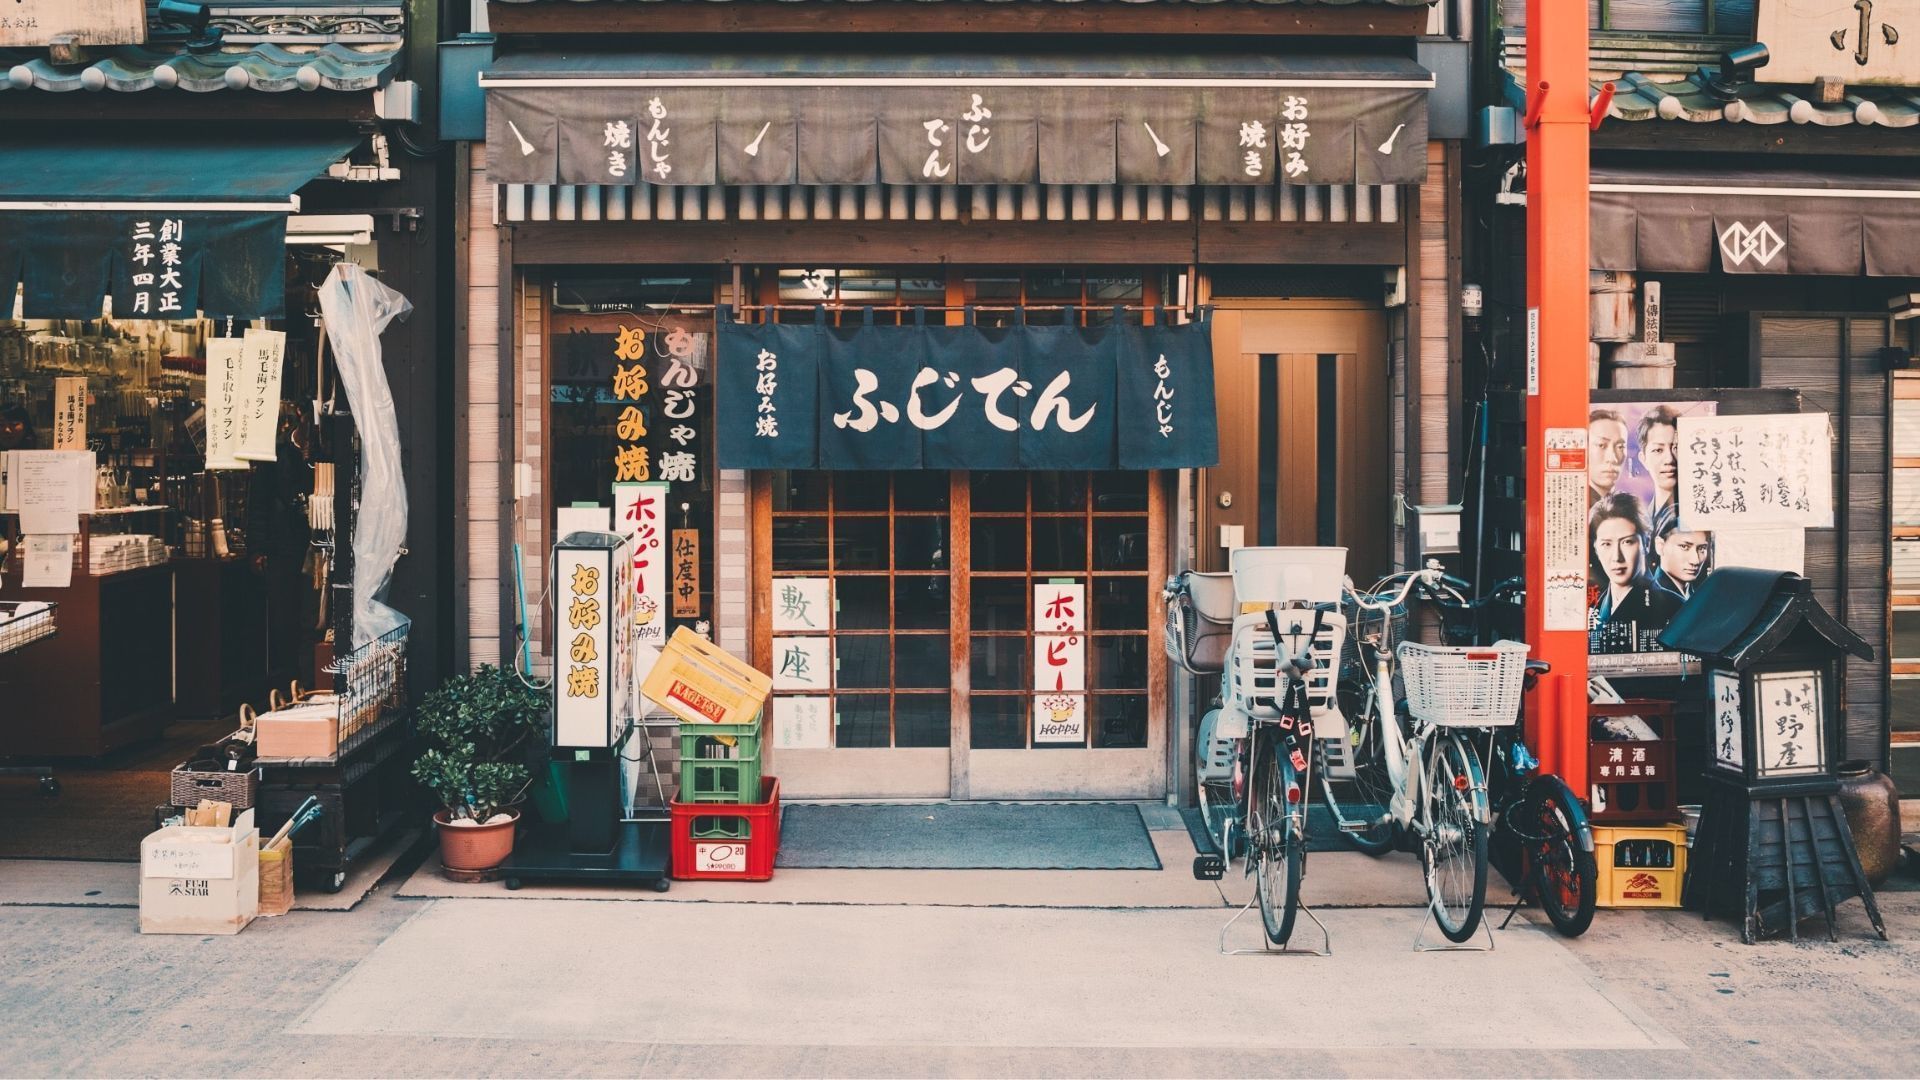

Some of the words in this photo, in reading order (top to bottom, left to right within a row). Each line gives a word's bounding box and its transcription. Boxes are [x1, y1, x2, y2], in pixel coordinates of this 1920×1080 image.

[604, 120, 631, 178] 焼き
[647, 96, 672, 180] もんじゃ
[923, 118, 951, 178] でん
[963, 93, 992, 153] ふじ
[1239, 121, 1267, 178] 焼き
[1281, 95, 1312, 178] お好み
[132, 221, 155, 314] 三年四月
[159, 219, 183, 312] 創業大正
[612, 324, 649, 482] お好み焼
[658, 326, 697, 482] もんじゃ焼
[755, 348, 779, 438] お好み焼
[833, 366, 1097, 433] ふじでん
[1153, 353, 1174, 438] もんじゃ
[626, 493, 659, 594] ホッピー
[675, 536, 696, 603] 仕度中
[567, 563, 601, 699] お好み焼
[1045, 591, 1078, 692] ホッピー
[1608, 747, 1646, 763] 清酒
[1720, 685, 1735, 760] 小野屋
[1774, 688, 1804, 768] 小野屋
[1599, 765, 1656, 777] 専用通箱
[185, 880, 208, 888] FUJI
[185, 888, 209, 896] STAR
